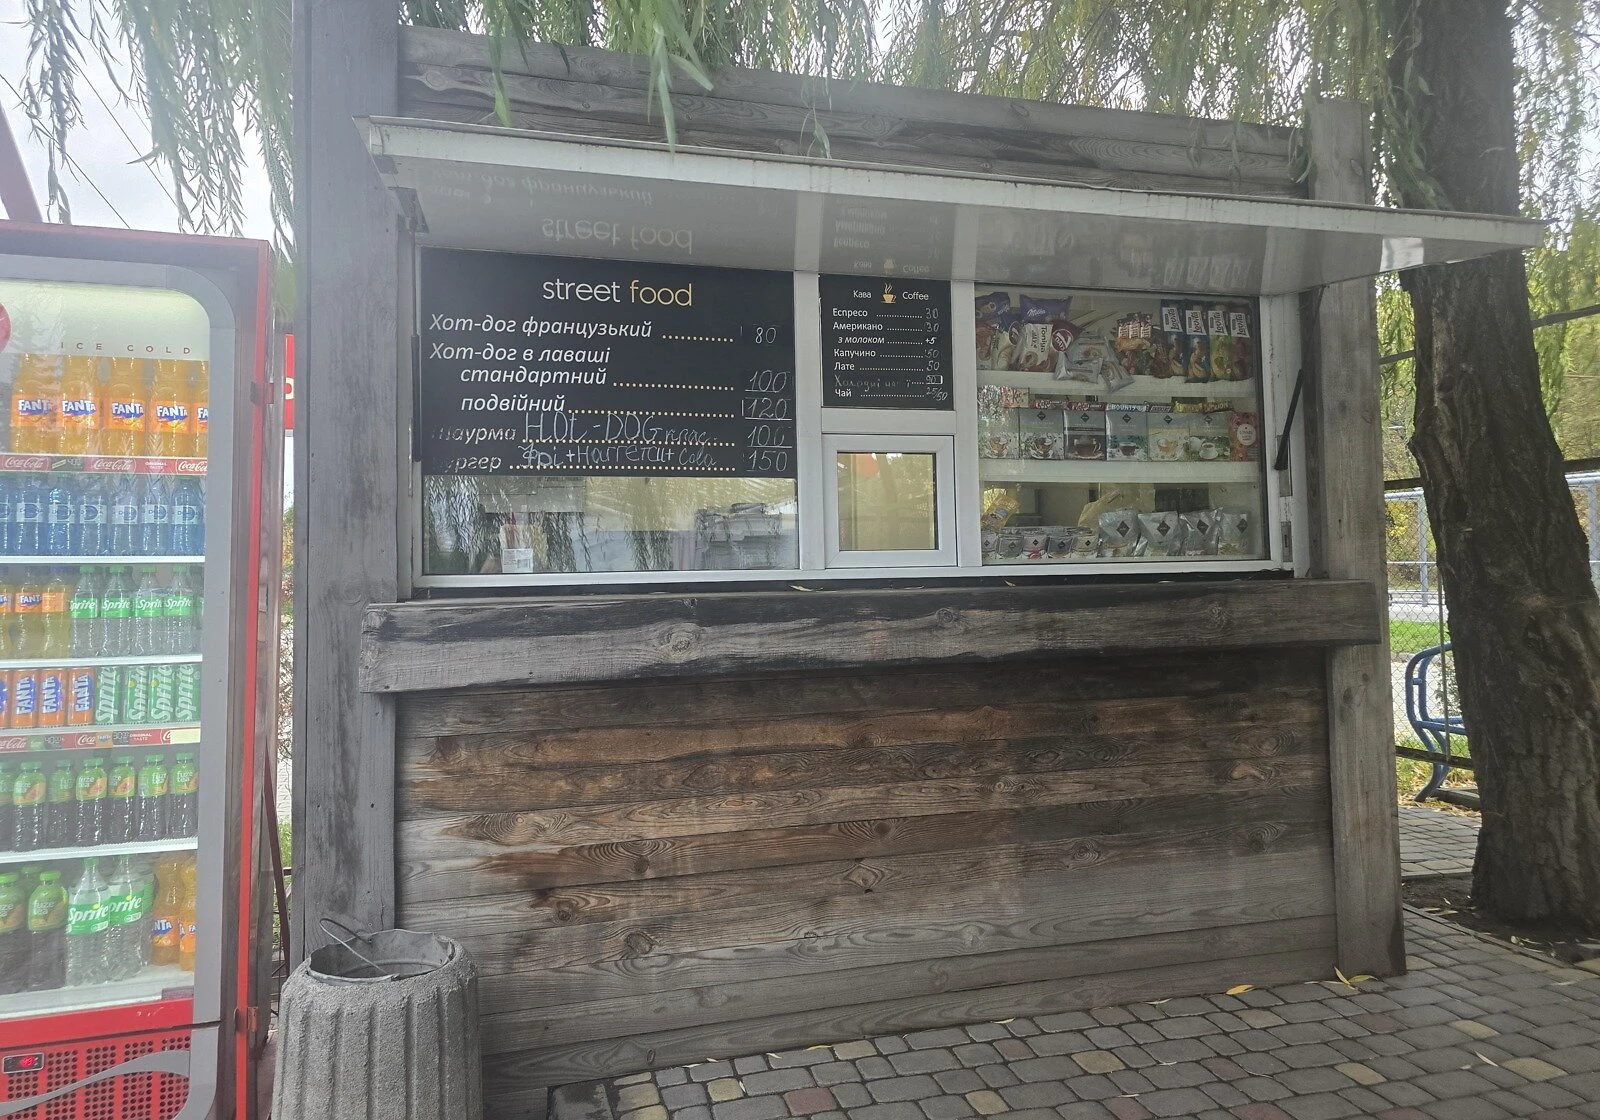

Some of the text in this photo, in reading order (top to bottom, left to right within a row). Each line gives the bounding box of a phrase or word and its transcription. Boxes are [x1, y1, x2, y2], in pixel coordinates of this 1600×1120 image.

[542, 278, 692, 307] street food
[853, 290, 929, 301] Кава Coffee
[832, 307, 868, 318] Еспресо
[429, 313, 777, 344] Хот-дог французький 80
[832, 321, 884, 331] Американо
[844, 336, 885, 344] молоком
[61, 342, 191, 354] ICE COLD
[429, 342, 611, 363] Хот-дог в лаваші
[833, 348, 876, 358] Капучино
[833, 361, 855, 371] Лате
[460, 366, 787, 393] стандартний 100
[835, 388, 852, 398] Чай
[62, 399, 96, 412] FANTA
[112, 402, 144, 414] FANTA
[156, 405, 188, 417] FANTA
[461, 394, 787, 421] подвійний 120
[434, 456, 502, 473] ургер
[748, 450, 788, 472] 150
[20, 594, 42, 604] FANT
[16, 676, 32, 715] FANTA
[42, 676, 57, 714] FANTA
[74, 674, 90, 712] FANTA
[109, 896, 142, 912] prite
[68, 904, 109, 925] Sprite
[154, 919, 173, 931] NTA
